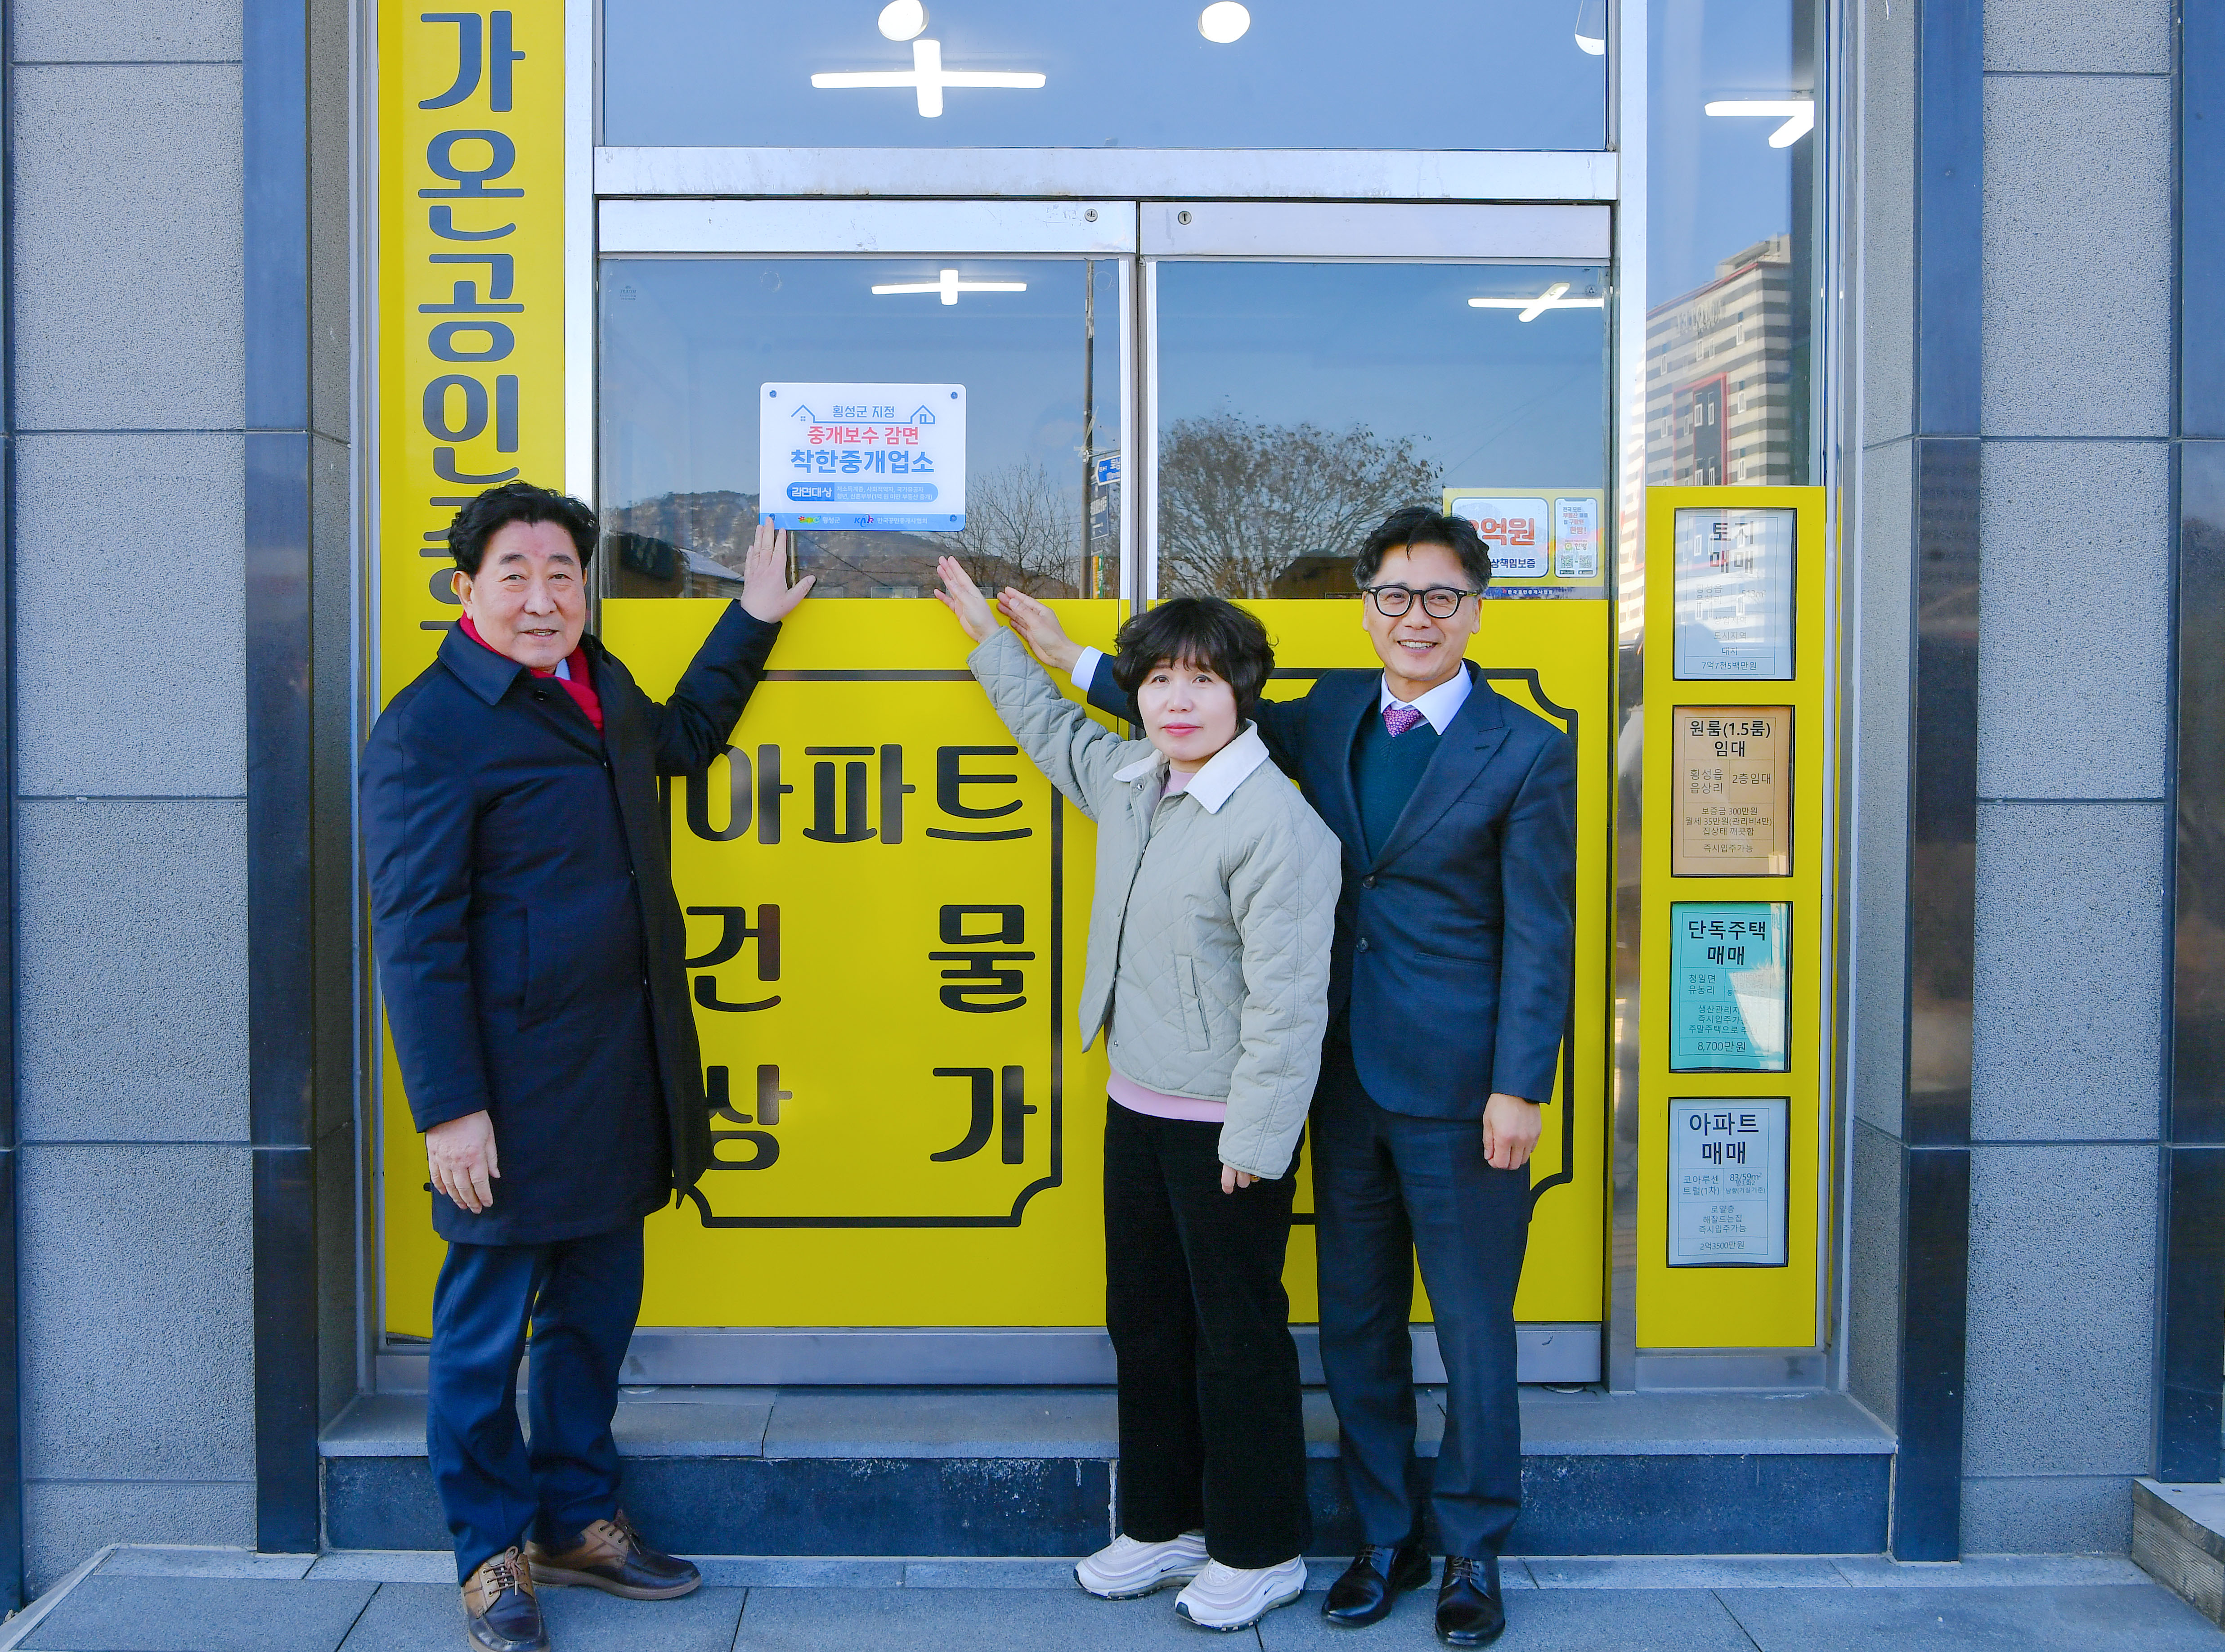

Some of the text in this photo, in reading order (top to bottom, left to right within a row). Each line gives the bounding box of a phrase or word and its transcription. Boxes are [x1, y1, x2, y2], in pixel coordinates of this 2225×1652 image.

[418, 11, 525, 638] 가온공인
[833, 405, 894, 418] 횡성군 지정
[807, 426, 919, 445] 중개보수 감면
[790, 449, 935, 474] 착한중개업소
[791, 487, 832, 498] 감면대상
[1709, 521, 1754, 544] 토지
[1709, 550, 1754, 574] 매매
[1713, 631, 1746, 640] 도시지역
[1722, 646, 1738, 656] 대지
[1702, 661, 1757, 671] 7억7천5백만원
[1690, 720, 1771, 738] 원룸(1.5룸)
[1714, 741, 1745, 757] 임대
[1690, 769, 1723, 780] 횡성읍
[1732, 773, 1771, 785] 2층임대
[686, 744, 1033, 844] 아파트
[1690, 783, 1723, 794] 읍상리
[1701, 807, 1758, 816] 보증금 300만원
[1686, 817, 1772, 826] 월세 35만원(관리비4만)
[1703, 827, 1754, 835] 집상태 깨끗함
[1704, 844, 1753, 853] 즉시입주가능
[1688, 920, 1766, 941] 단독주택
[1708, 946, 1745, 965] 매매
[1689, 974, 1715, 983] 청일면
[1688, 985, 1714, 995] 유동리
[1698, 1005, 1748, 1015] 생산관리지
[1689, 1025, 1738, 1034] 주말주택으로
[1697, 1041, 1745, 1053] 8,700만원
[1690, 1112, 1759, 1136] 아파트
[1702, 1141, 1745, 1165] 매매
[1683, 1175, 1719, 1185] 코아루센
[1683, 1186, 1720, 1196] 트럴(1차)
[1711, 1205, 1735, 1213] 로얄층
[1703, 1214, 1742, 1224] 해잘드는집
[1699, 1224, 1747, 1234] 즉시입주가능
[1700, 1241, 1744, 1250] 2억3500만원
